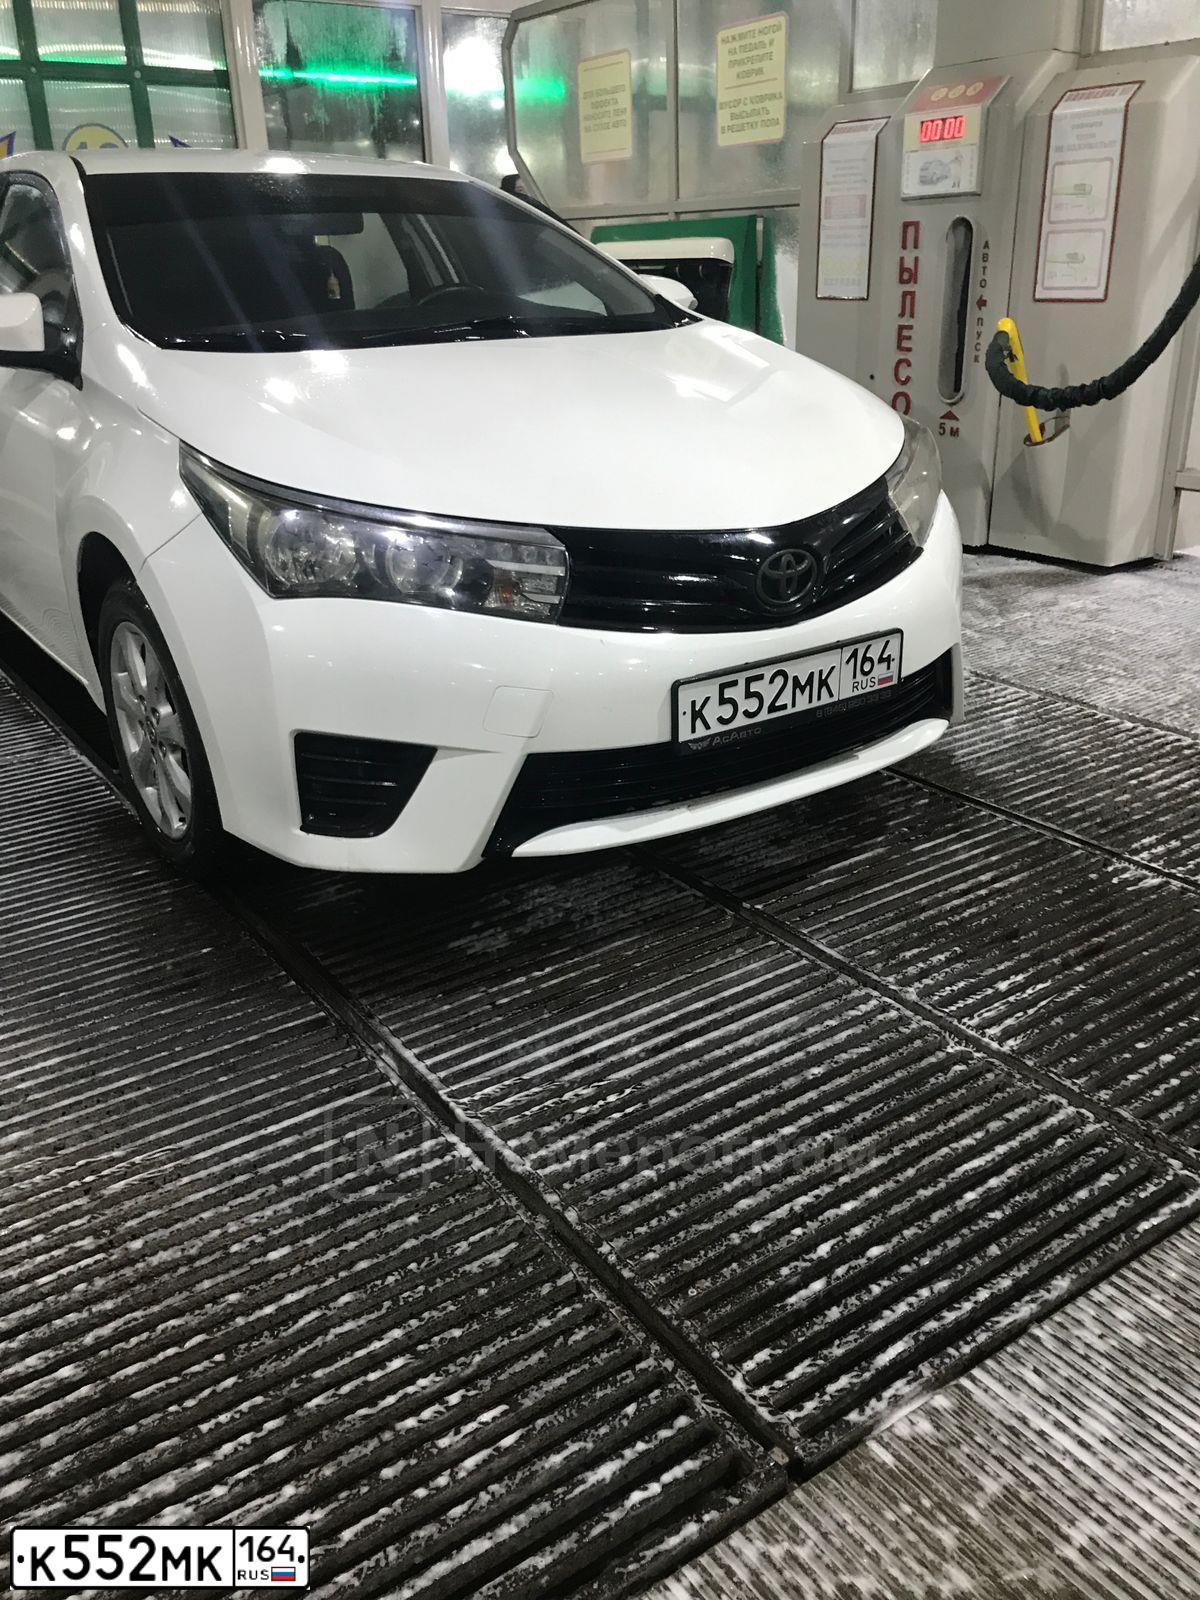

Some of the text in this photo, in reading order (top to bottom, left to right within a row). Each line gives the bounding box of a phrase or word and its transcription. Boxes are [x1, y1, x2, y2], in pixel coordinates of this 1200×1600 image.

[758, 21, 782, 37] НОГОЙ
[727, 47, 737, 56] НА
[979, 240, 990, 289] АВТО
[973, 317, 984, 364] ПУСК
[938, 422, 946, 437] 5
[690, 640, 894, 734] К552МК 164
[851, 677, 876, 693] RUS
